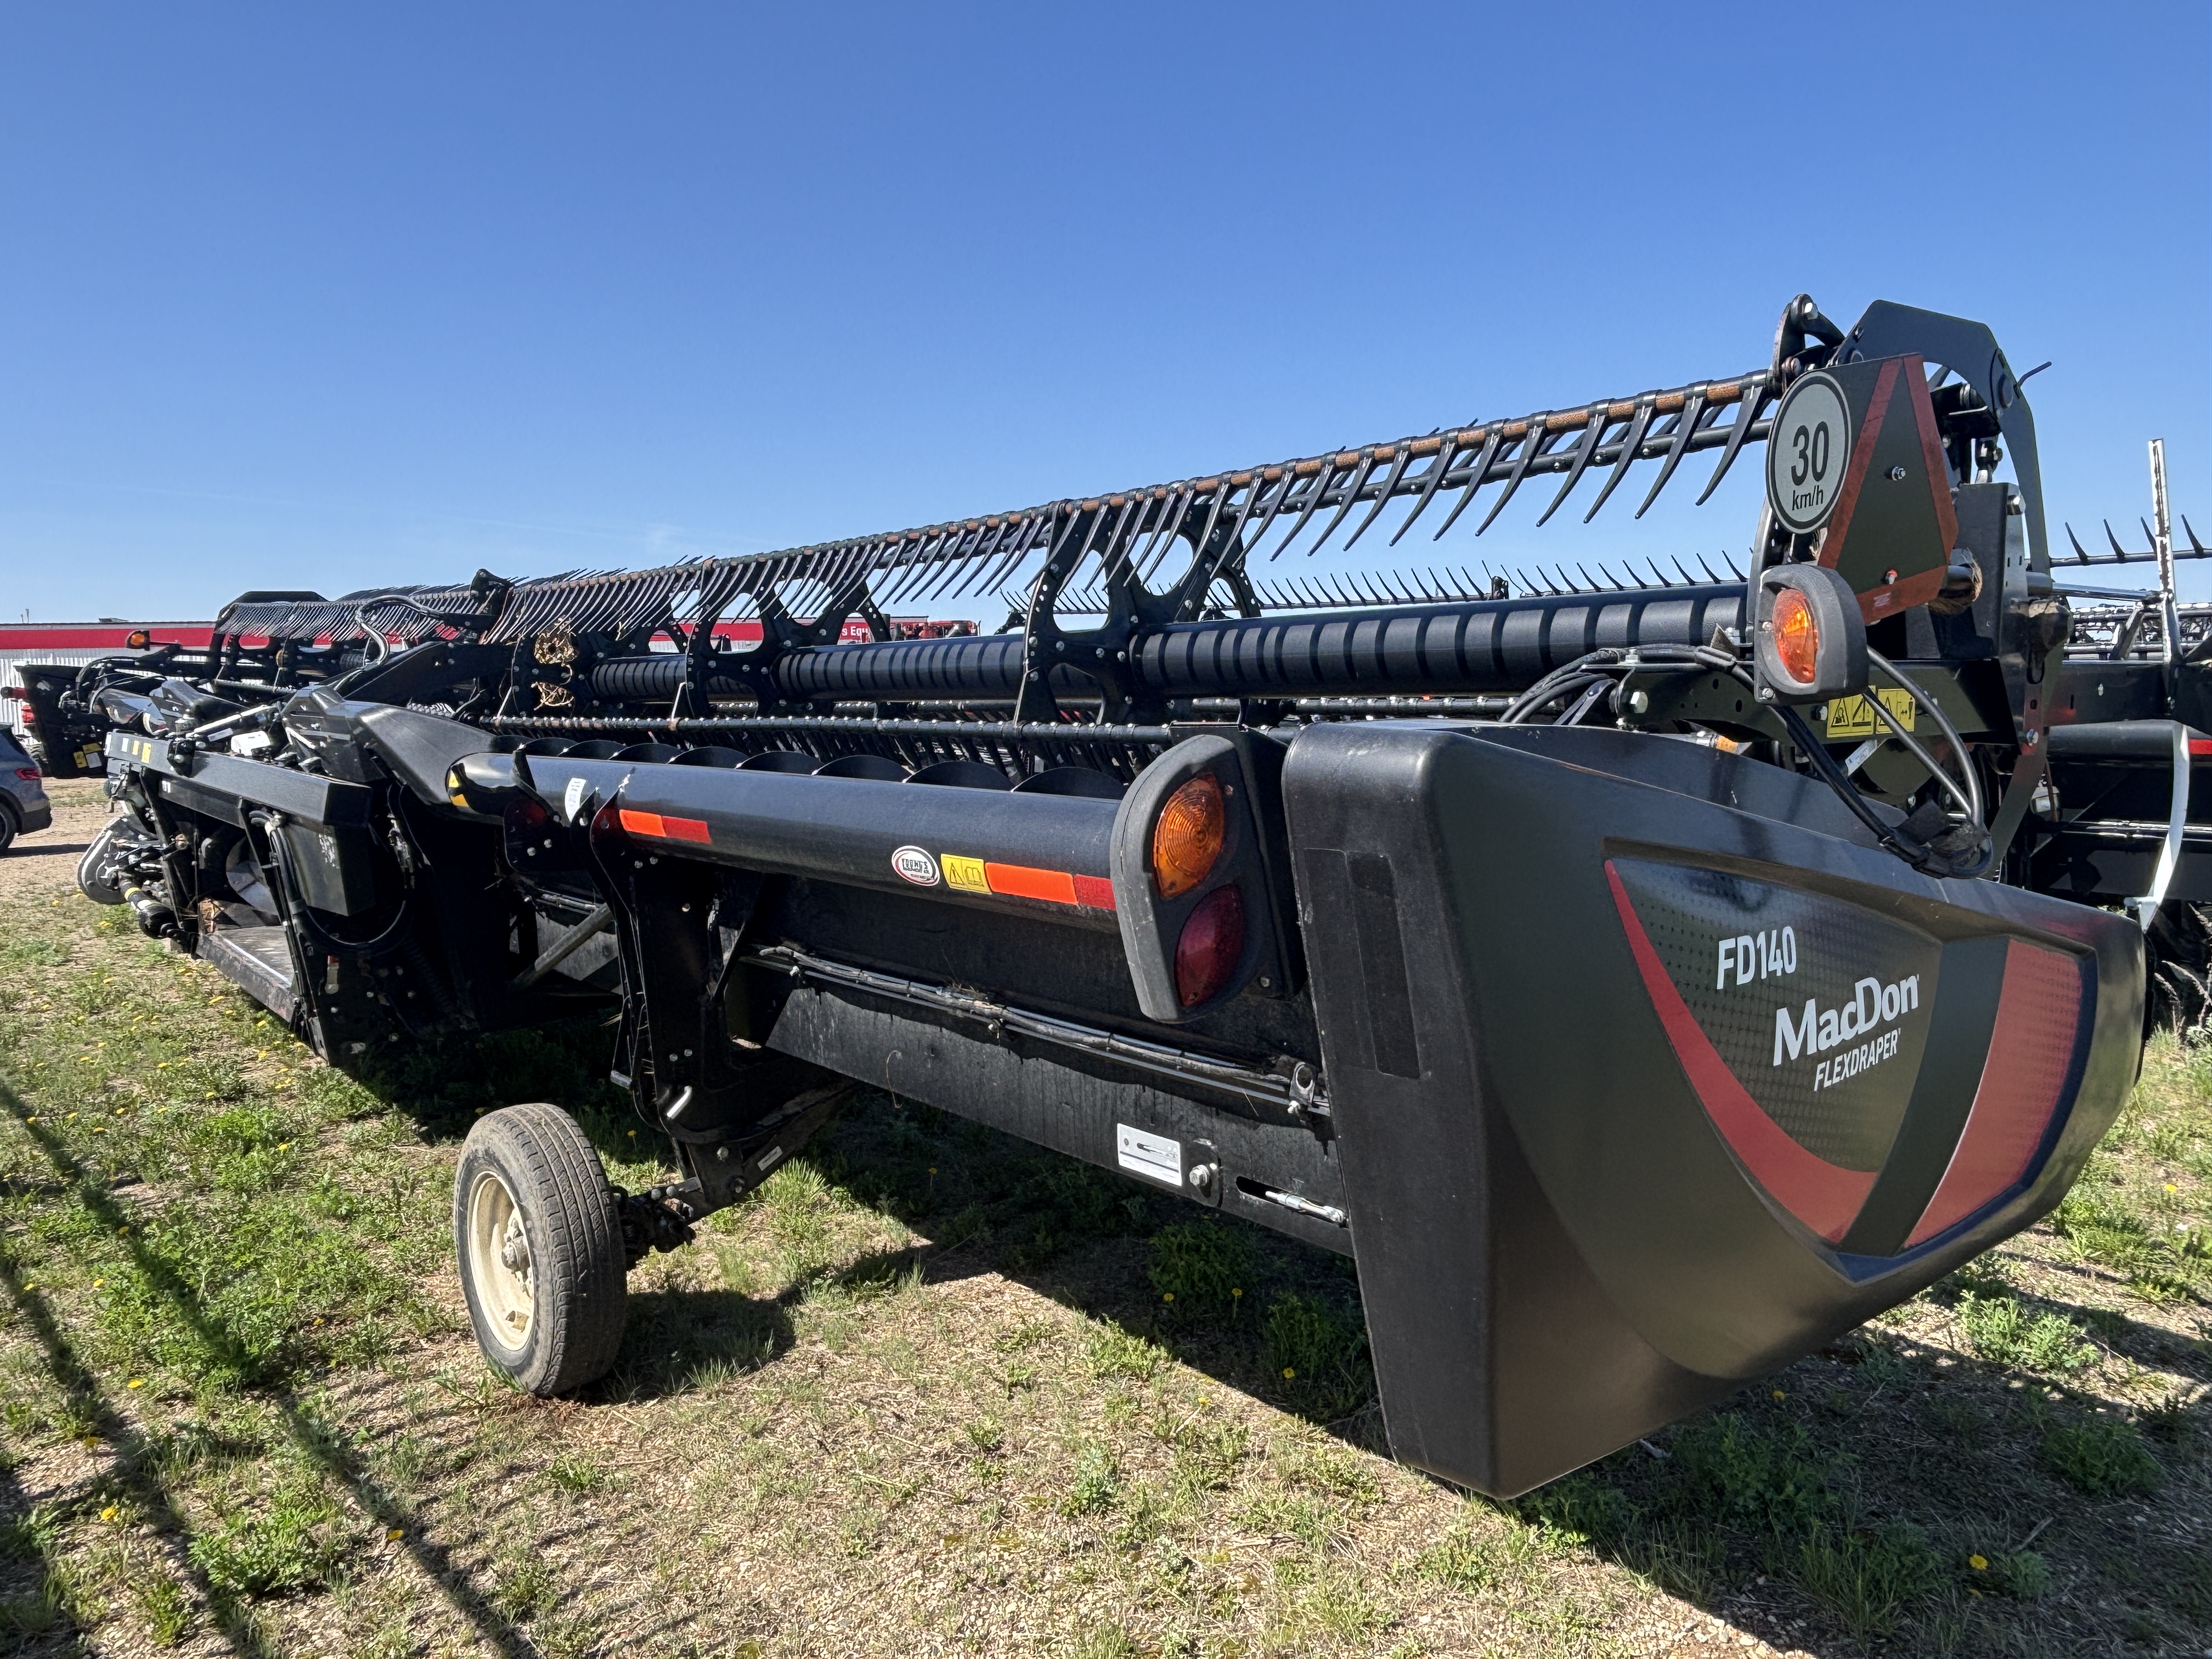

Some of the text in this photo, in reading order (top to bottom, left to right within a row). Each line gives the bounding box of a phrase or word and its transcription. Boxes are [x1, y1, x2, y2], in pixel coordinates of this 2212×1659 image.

[1791, 421, 1829, 486] 30
[1792, 485, 1824, 511] km/h
[1717, 926, 1797, 990] FD140
[1773, 975, 1919, 1066] MacDon
[1814, 1029, 1899, 1092] FLEXDRAPER
